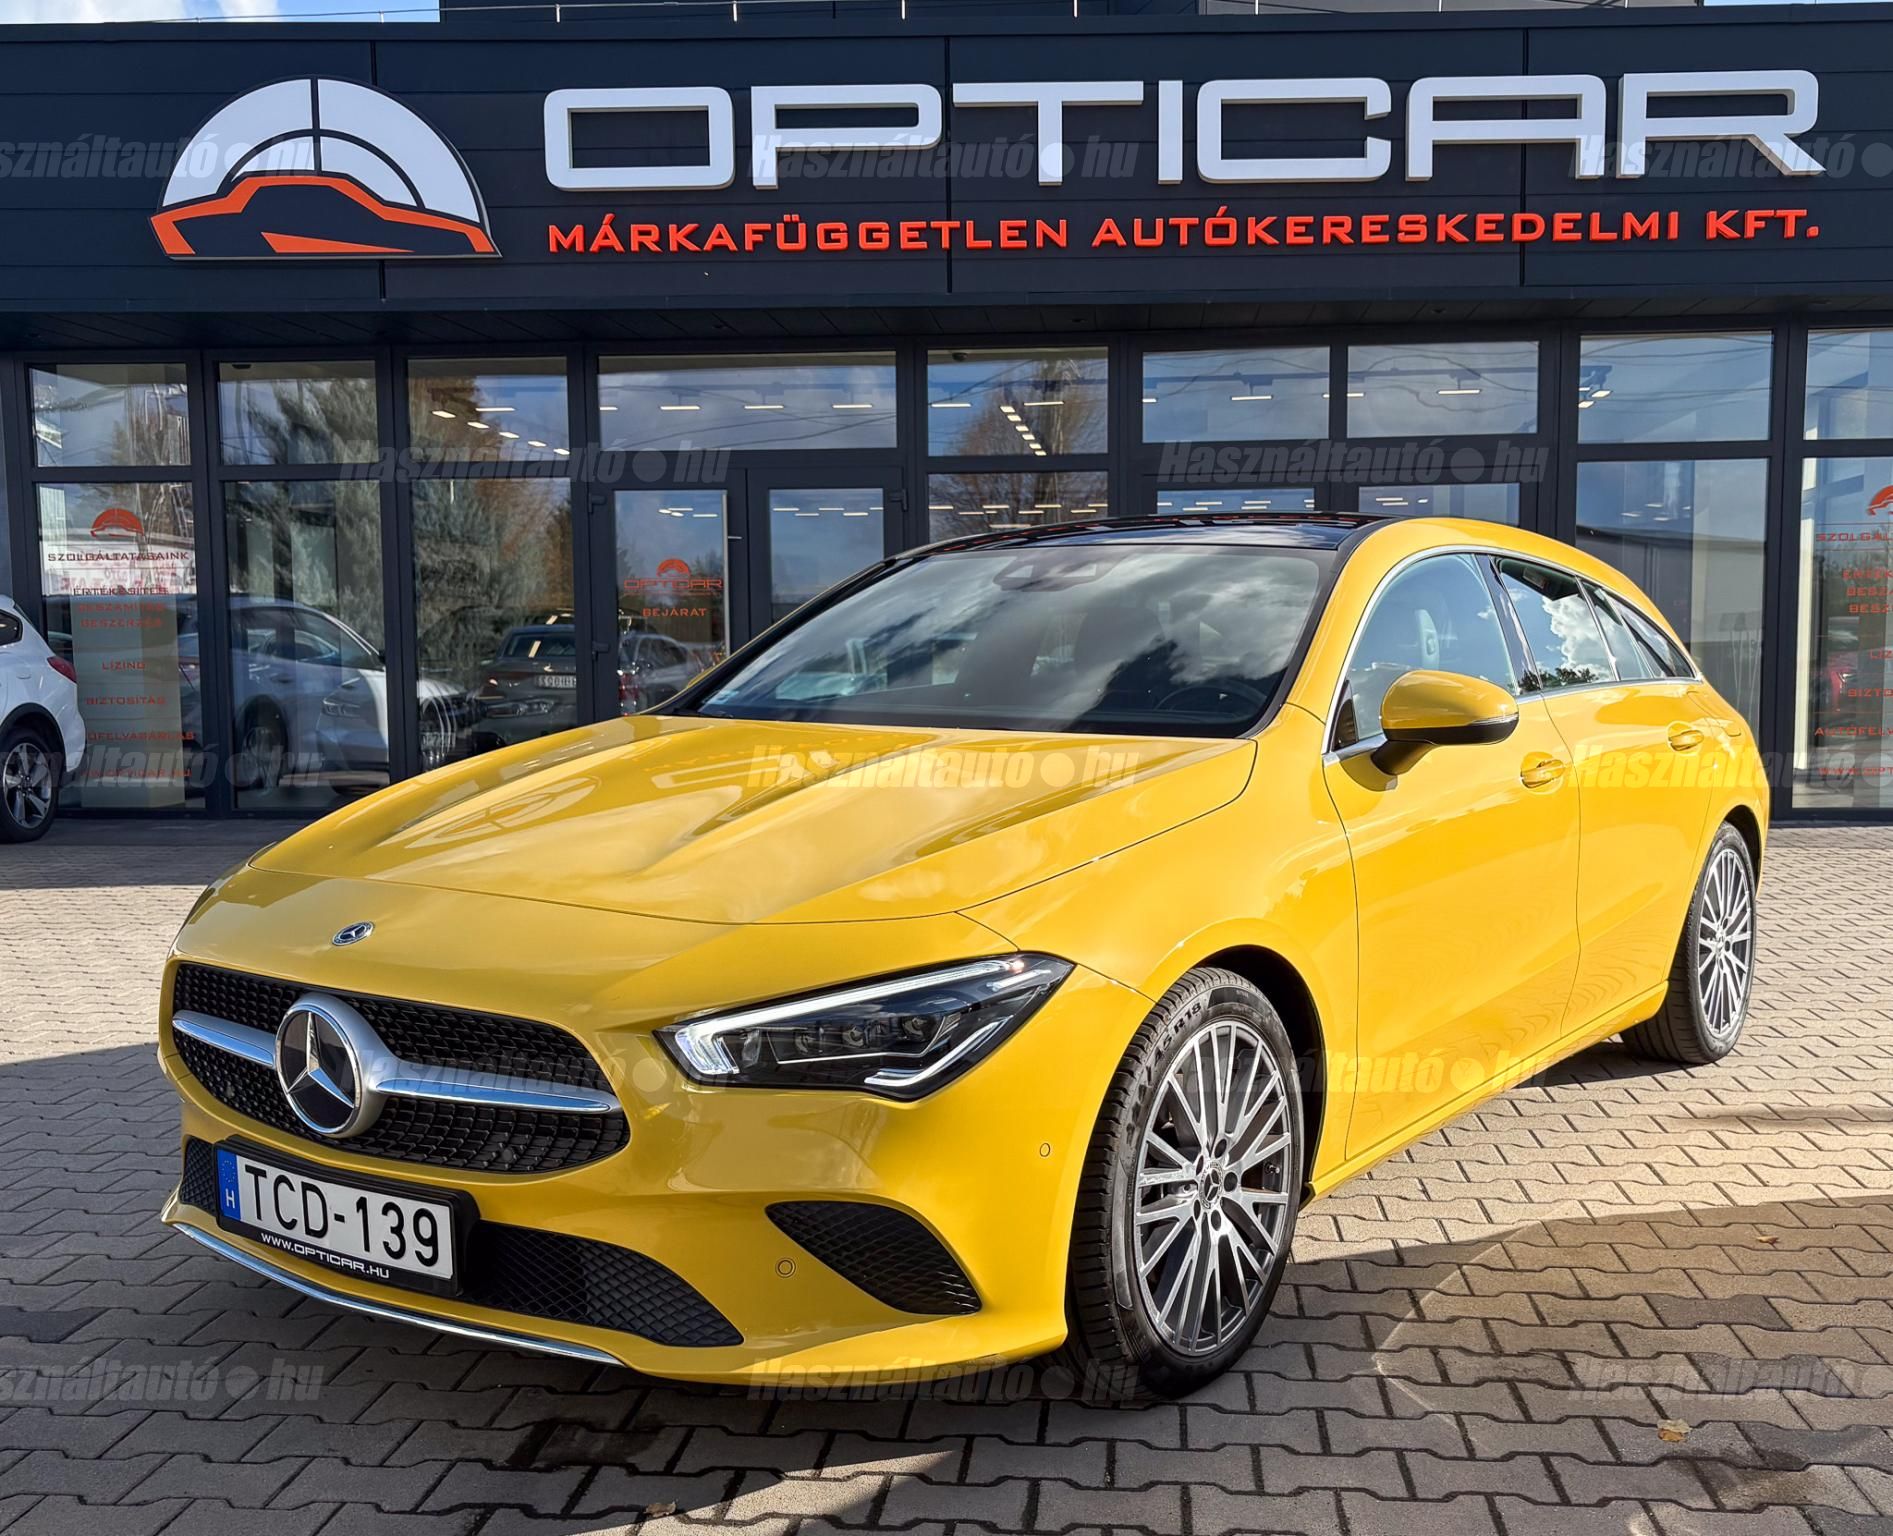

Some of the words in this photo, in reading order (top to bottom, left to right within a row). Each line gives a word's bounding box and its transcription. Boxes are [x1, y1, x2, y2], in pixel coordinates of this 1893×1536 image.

[544, 70, 1826, 191] OPTICAR
[548, 213, 1068, 253] MÁRKAFÜGGETLEN
[1092, 206, 1680, 248] AUTÓKERESKEDELMI
[1705, 208, 1820, 240] KFT.
[1173, 1002, 1202, 1036] R18
[225, 1188, 235, 1209] H
[245, 1164, 439, 1267] TCD-139
[261, 1232, 390, 1279] WWW.OPTICAR.HU
